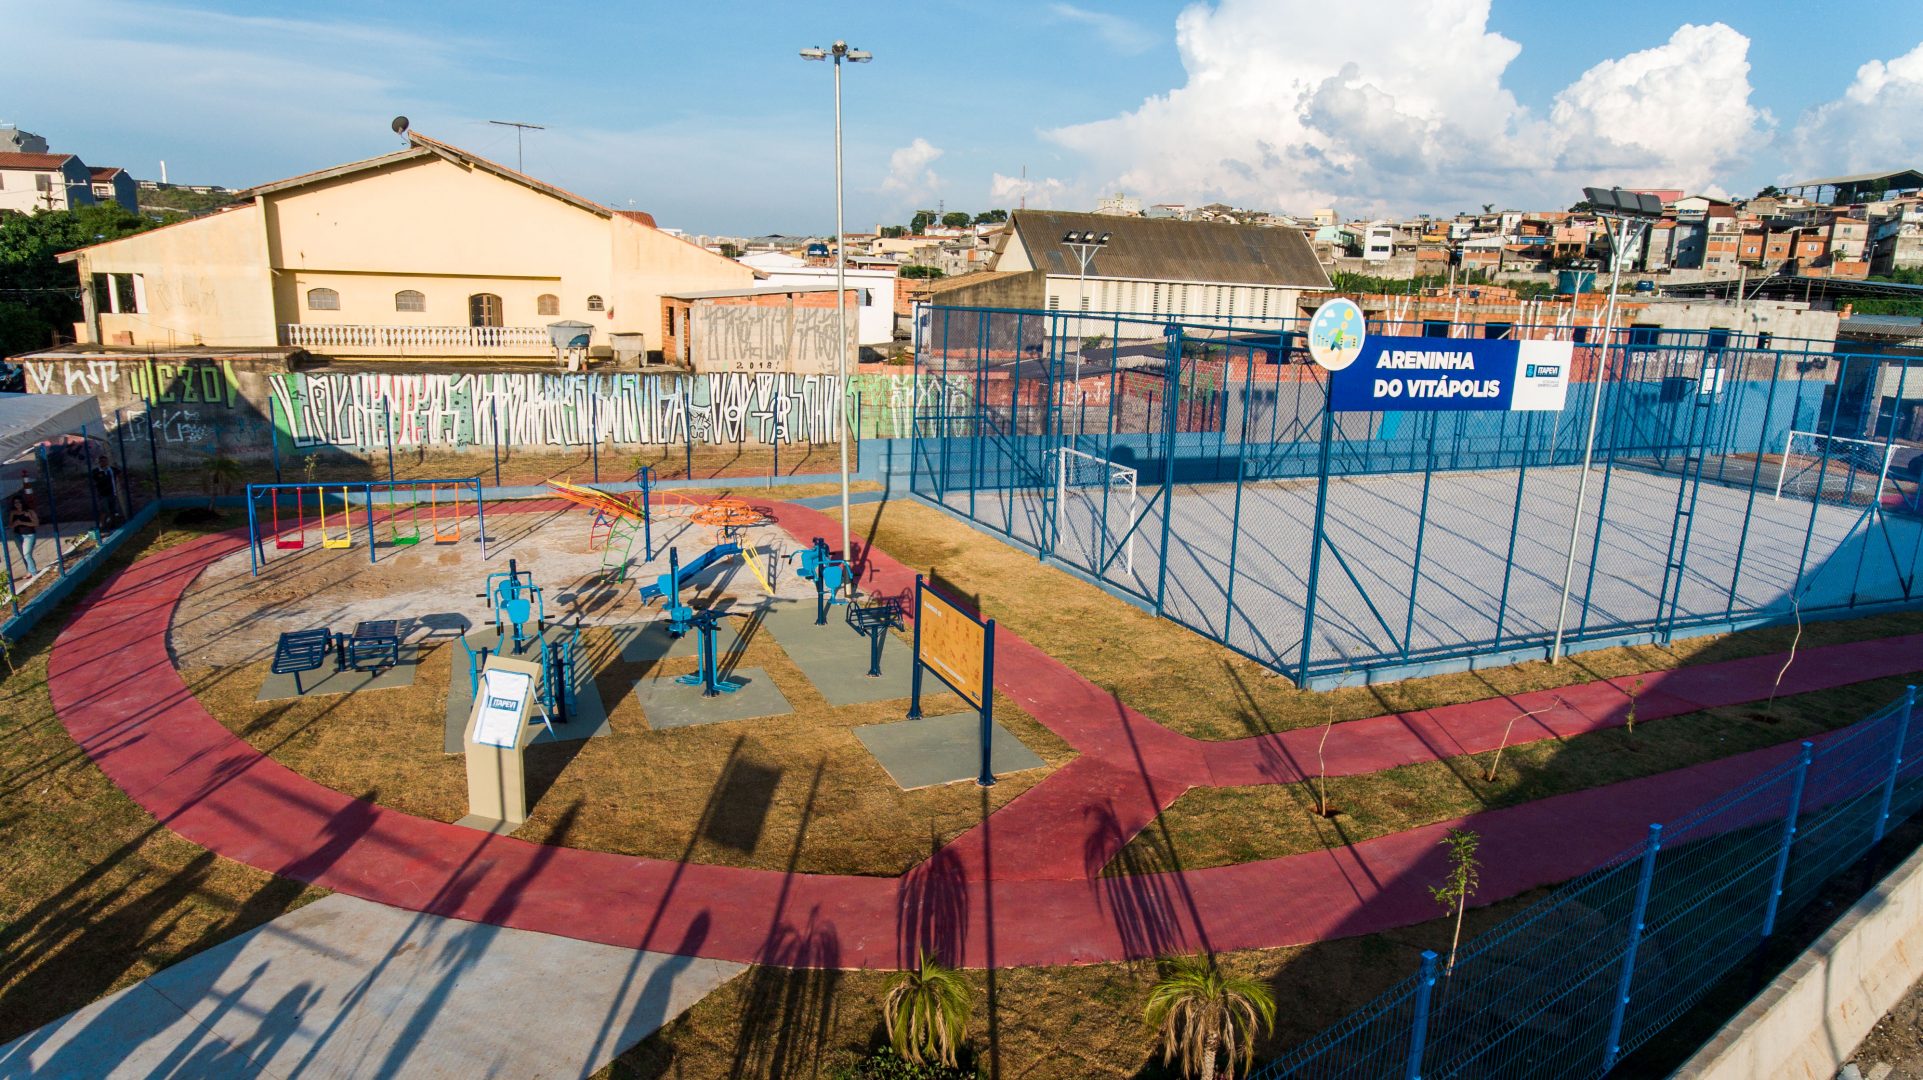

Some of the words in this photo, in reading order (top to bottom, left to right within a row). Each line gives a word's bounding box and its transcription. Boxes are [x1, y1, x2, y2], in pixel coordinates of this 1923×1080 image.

[1375, 350, 1475, 370] ARENINHA
[1537, 366, 1559, 375] ITAPEVI
[1373, 378, 1403, 398] DO
[1407, 374, 1500, 398] VITÁPOLIS
[493, 698, 517, 709] ITAPEVI
